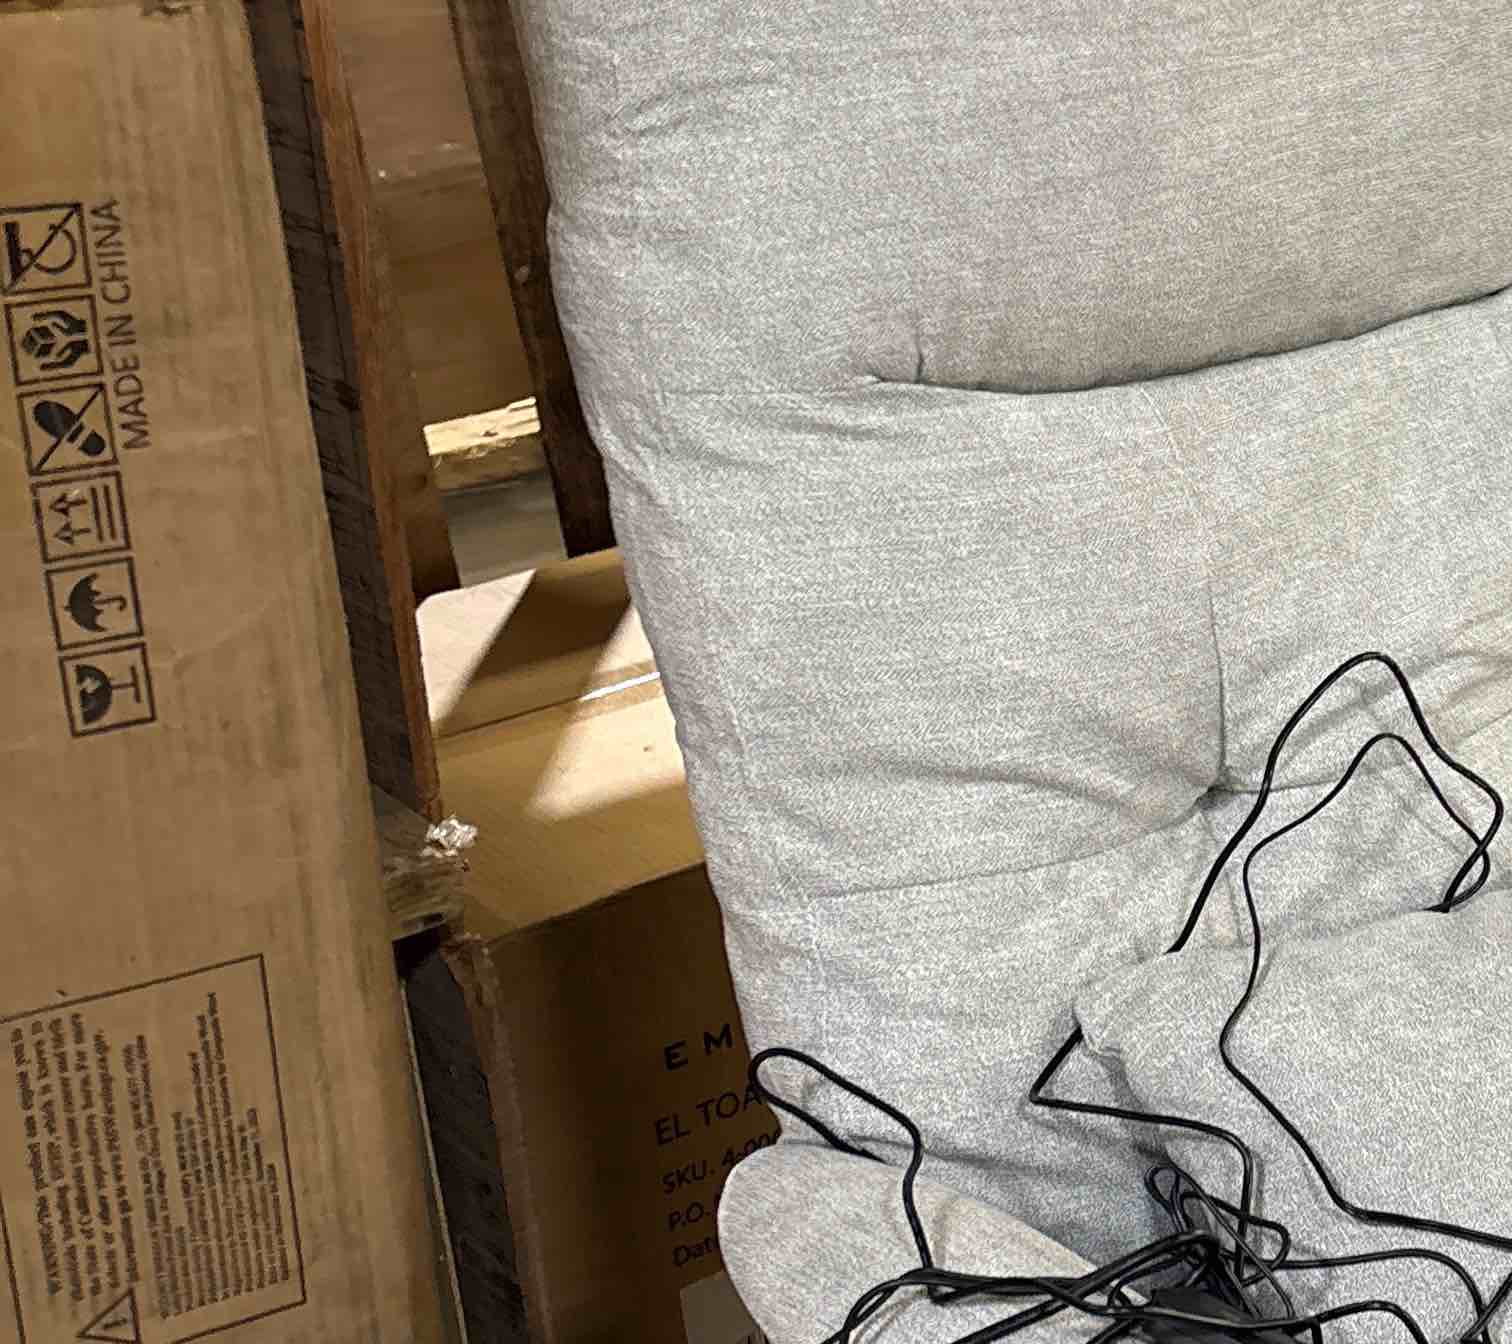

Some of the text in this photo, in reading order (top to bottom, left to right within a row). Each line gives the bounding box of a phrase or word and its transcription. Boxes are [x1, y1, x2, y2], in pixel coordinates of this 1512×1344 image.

[91, 198, 151, 451] MADE IN CHINA
[655, 1113, 691, 1146] EL
